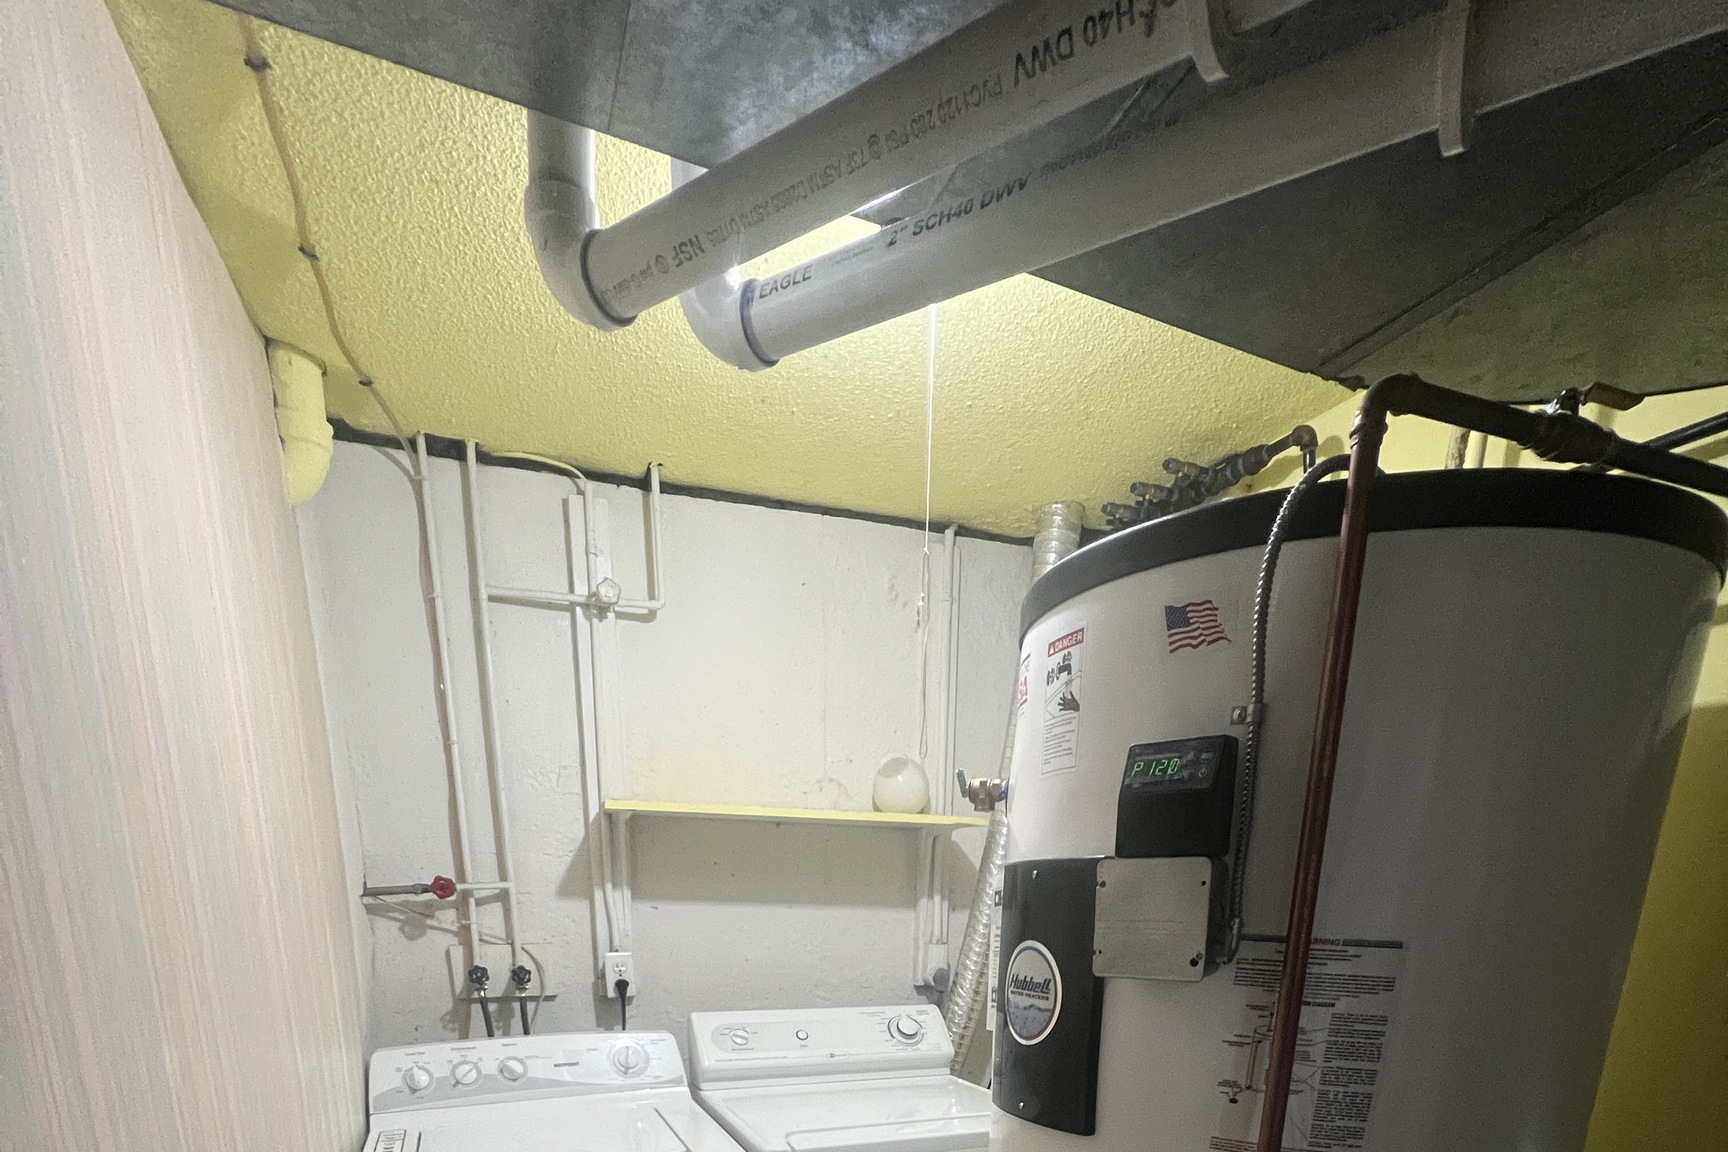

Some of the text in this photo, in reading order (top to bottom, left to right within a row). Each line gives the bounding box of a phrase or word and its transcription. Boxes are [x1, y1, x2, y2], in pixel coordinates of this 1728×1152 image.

[1014, 24, 1075, 88] DWV
[867, 133, 881, 161] @
[759, 264, 813, 299] EAGLE
[912, 198, 973, 237] SCH40
[980, 171, 1032, 209] DWV
[671, 234, 705, 268] NSF
[1054, 631, 1084, 653] DANGER
[1130, 757, 1181, 779] P 120
[1308, 937, 1341, 947] ARNING
[1010, 974, 1052, 995] Hubbell
[1025, 993, 1050, 1001] HEATERS
